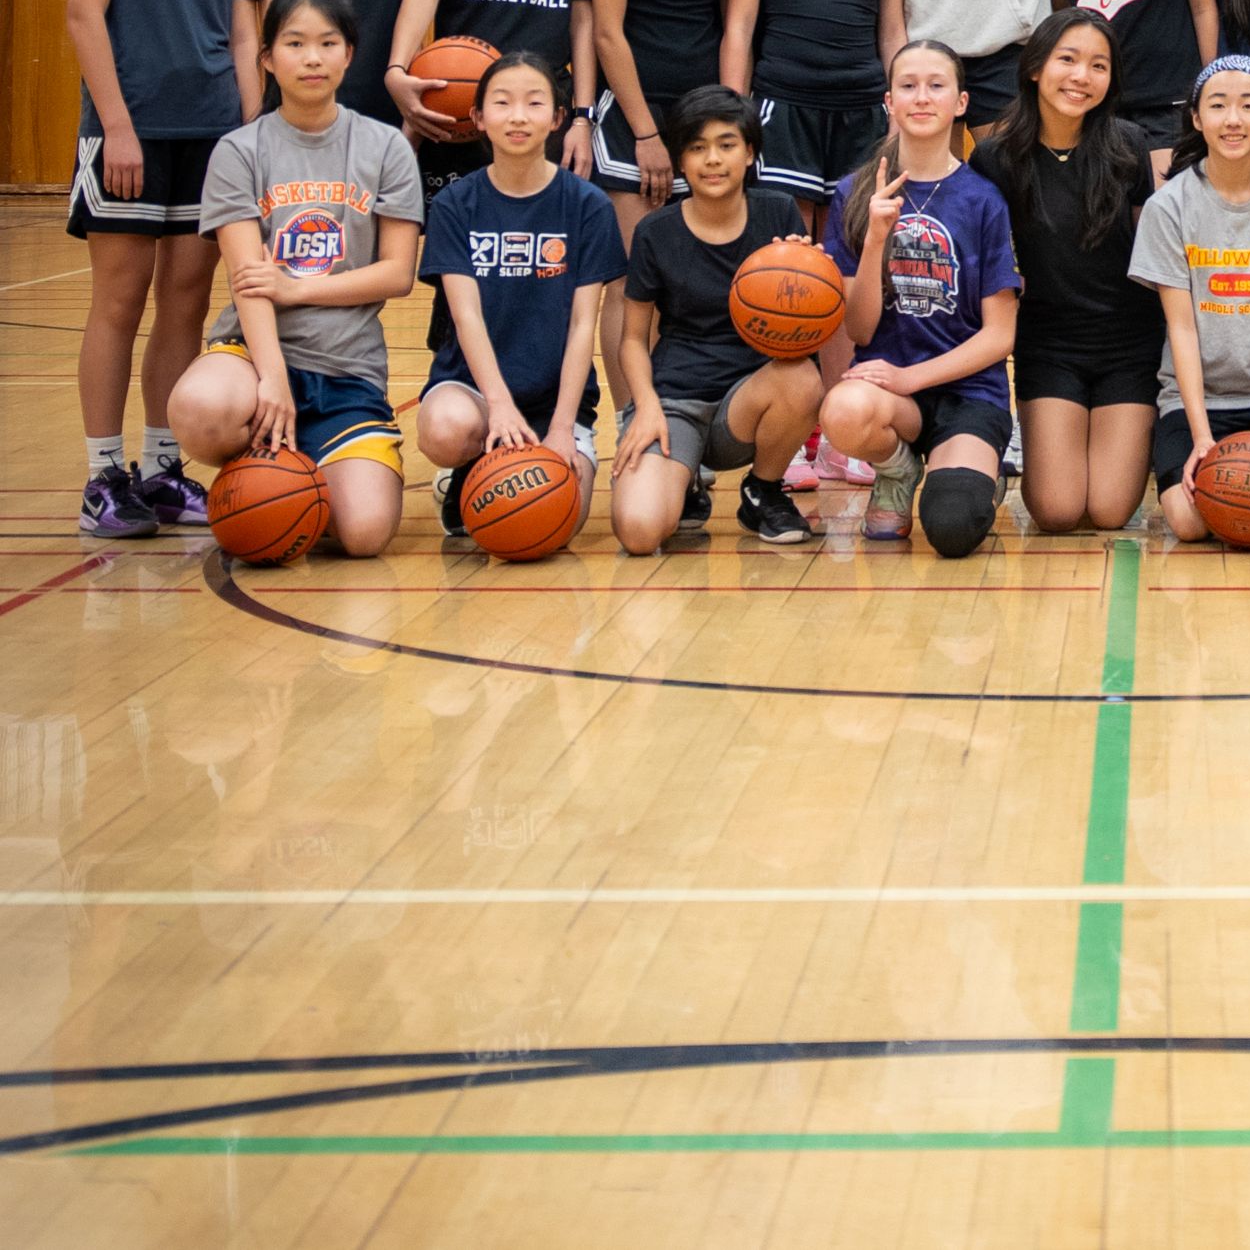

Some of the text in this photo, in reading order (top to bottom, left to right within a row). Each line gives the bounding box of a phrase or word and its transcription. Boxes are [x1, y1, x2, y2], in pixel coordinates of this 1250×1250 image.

[282, 232, 341, 259] LGSR
[475, 266, 491, 278] AT
[1200, 301, 1235, 315] MIDDLE
[745, 316, 823, 342] Baden
[470, 465, 551, 514] Wilson
